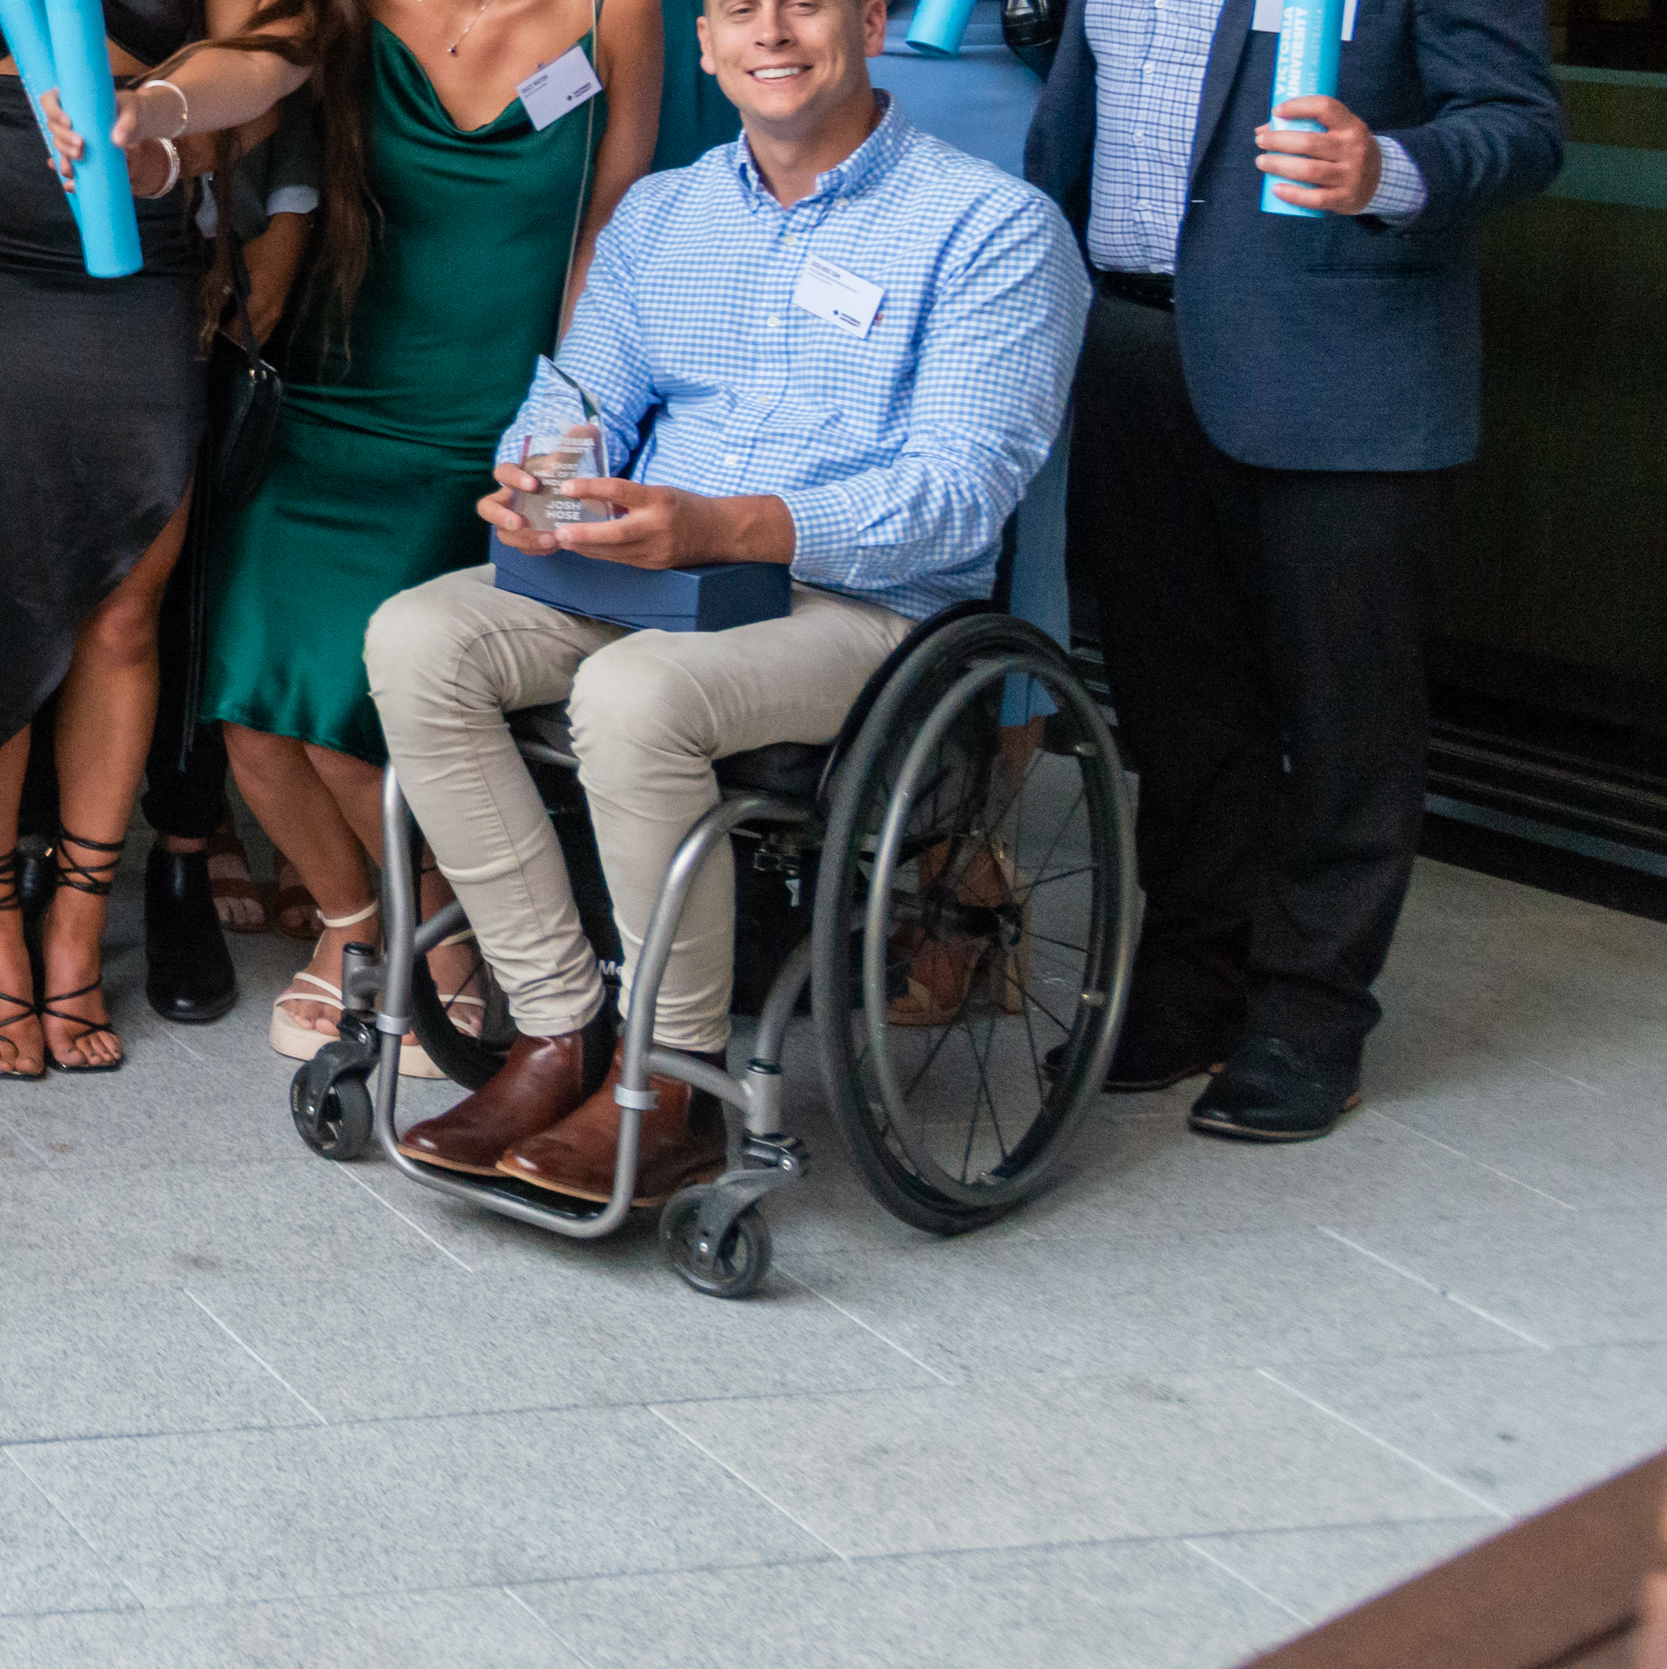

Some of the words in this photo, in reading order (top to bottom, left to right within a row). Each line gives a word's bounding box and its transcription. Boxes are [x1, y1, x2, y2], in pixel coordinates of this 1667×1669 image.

[1275, 6, 1294, 95] VICTORIA
[1287, 6, 1308, 97] UNIVERSITY
[546, 500, 581, 511] JOSH
[546, 510, 581, 521] HOSE
